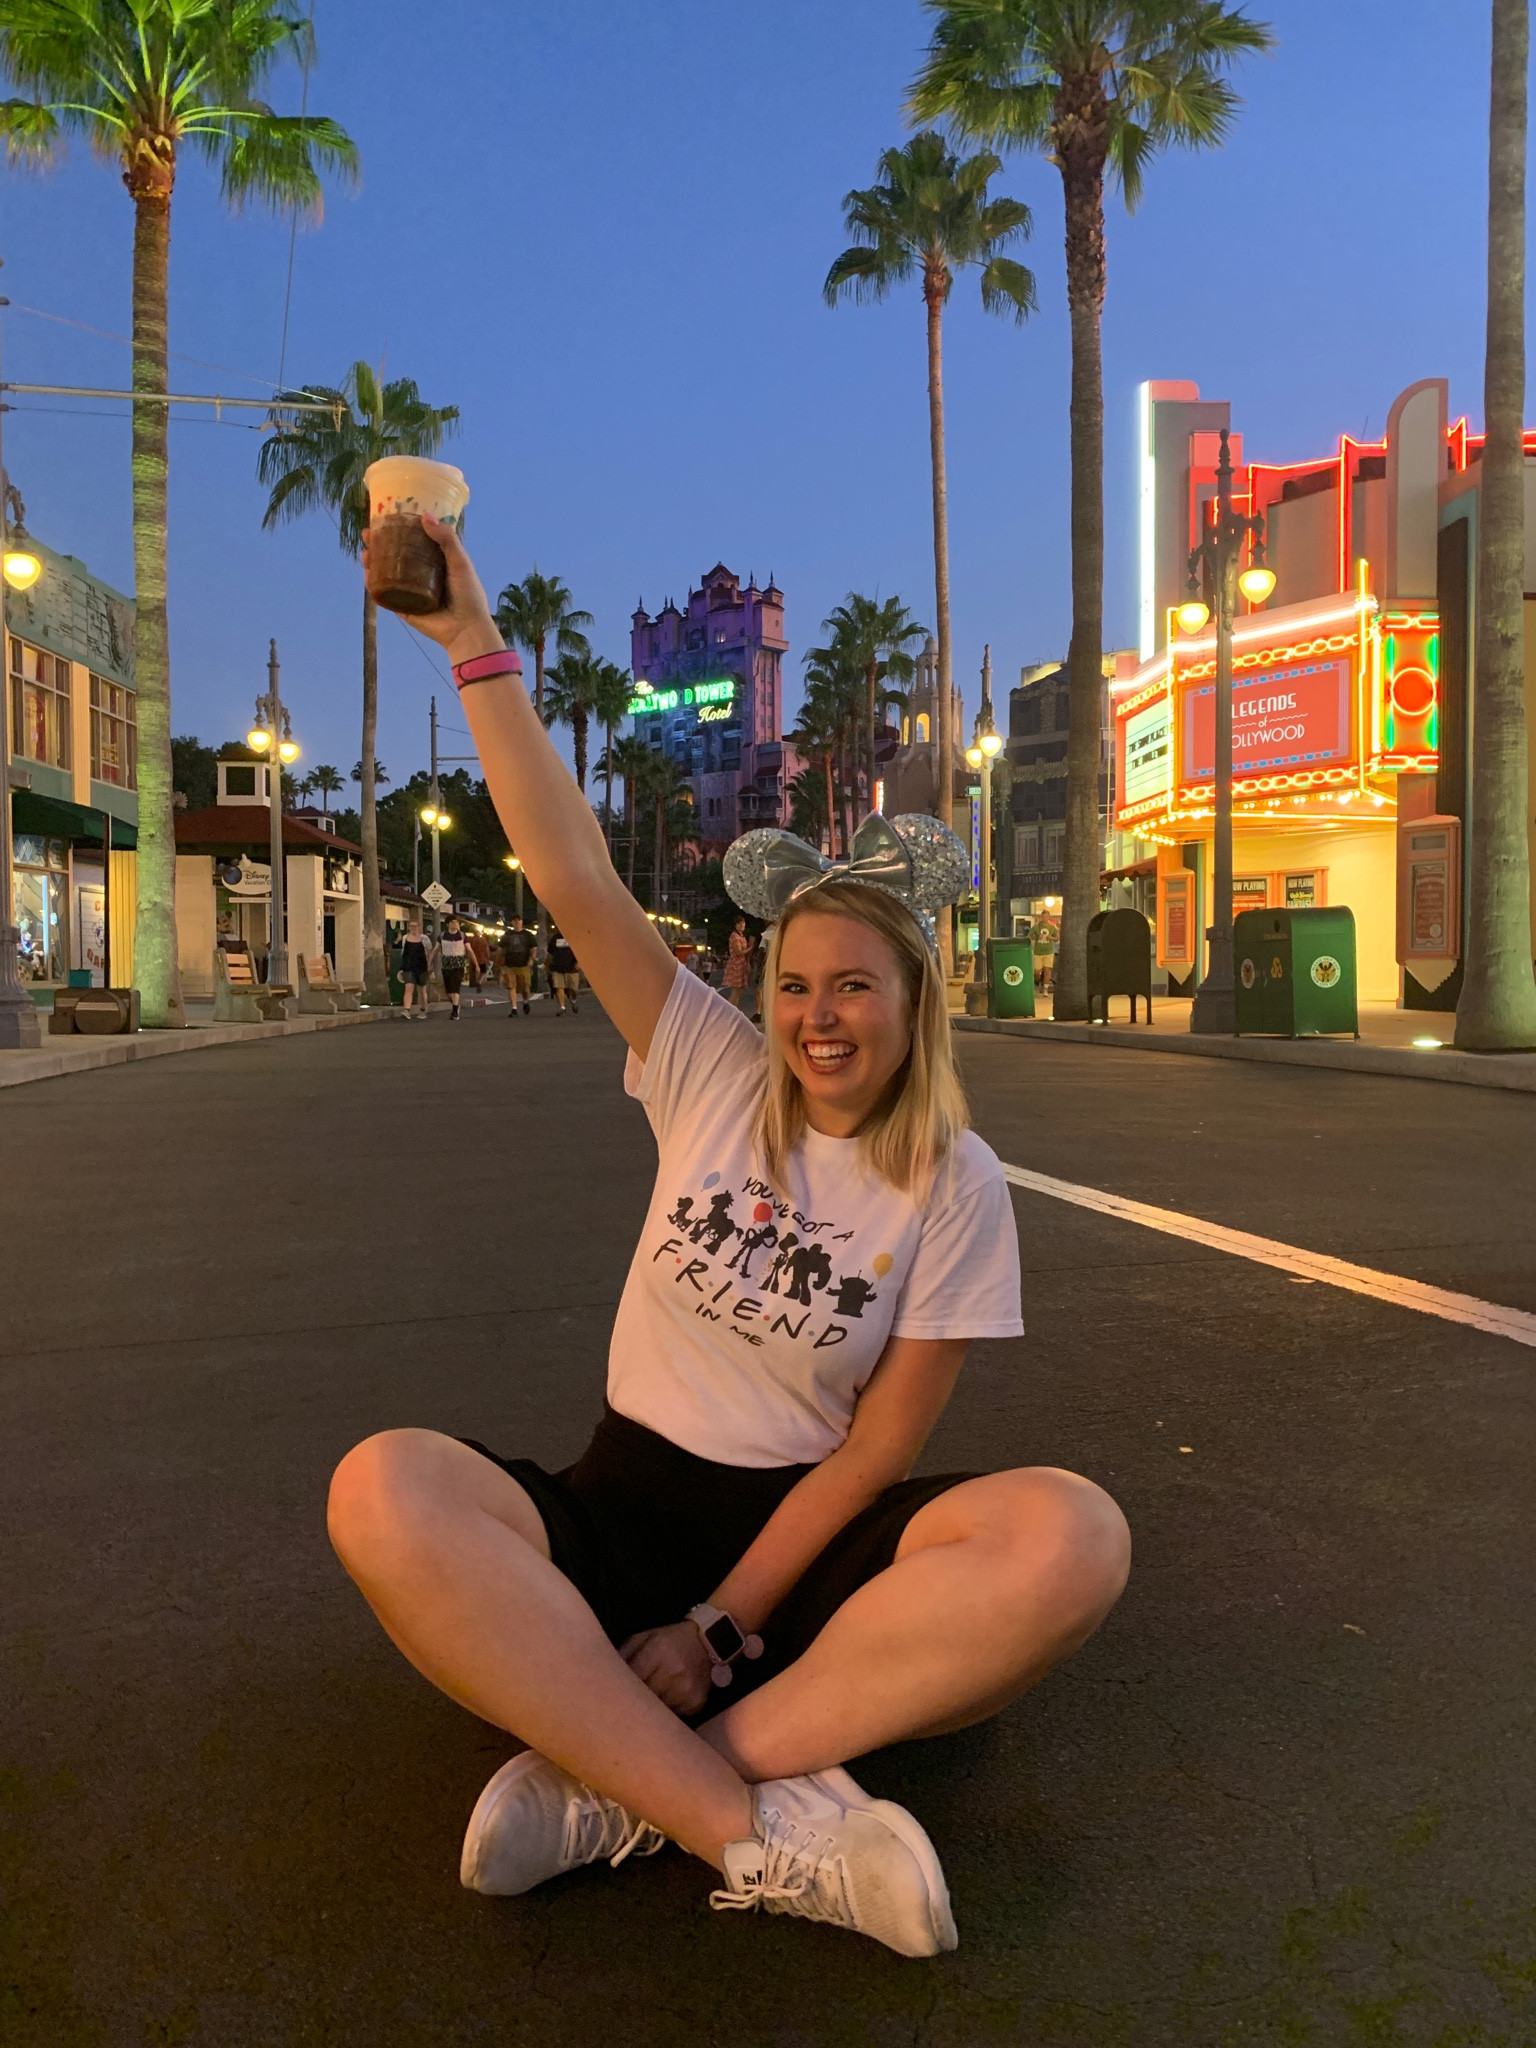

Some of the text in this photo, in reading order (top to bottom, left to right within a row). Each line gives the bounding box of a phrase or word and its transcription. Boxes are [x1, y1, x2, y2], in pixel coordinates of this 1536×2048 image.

[695, 681, 735, 703] TOWER
[697, 702, 733, 723] Hotel
[1232, 692, 1297, 719] LEGENDS
[1258, 715, 1268, 728] of
[1231, 724, 1305, 749] OLLYWOOD
[242, 870, 270, 882] Disney
[792, 1211, 835, 1235] GOT
[832, 1230, 855, 1242] A
[696, 1302, 766, 1347] IN ME
